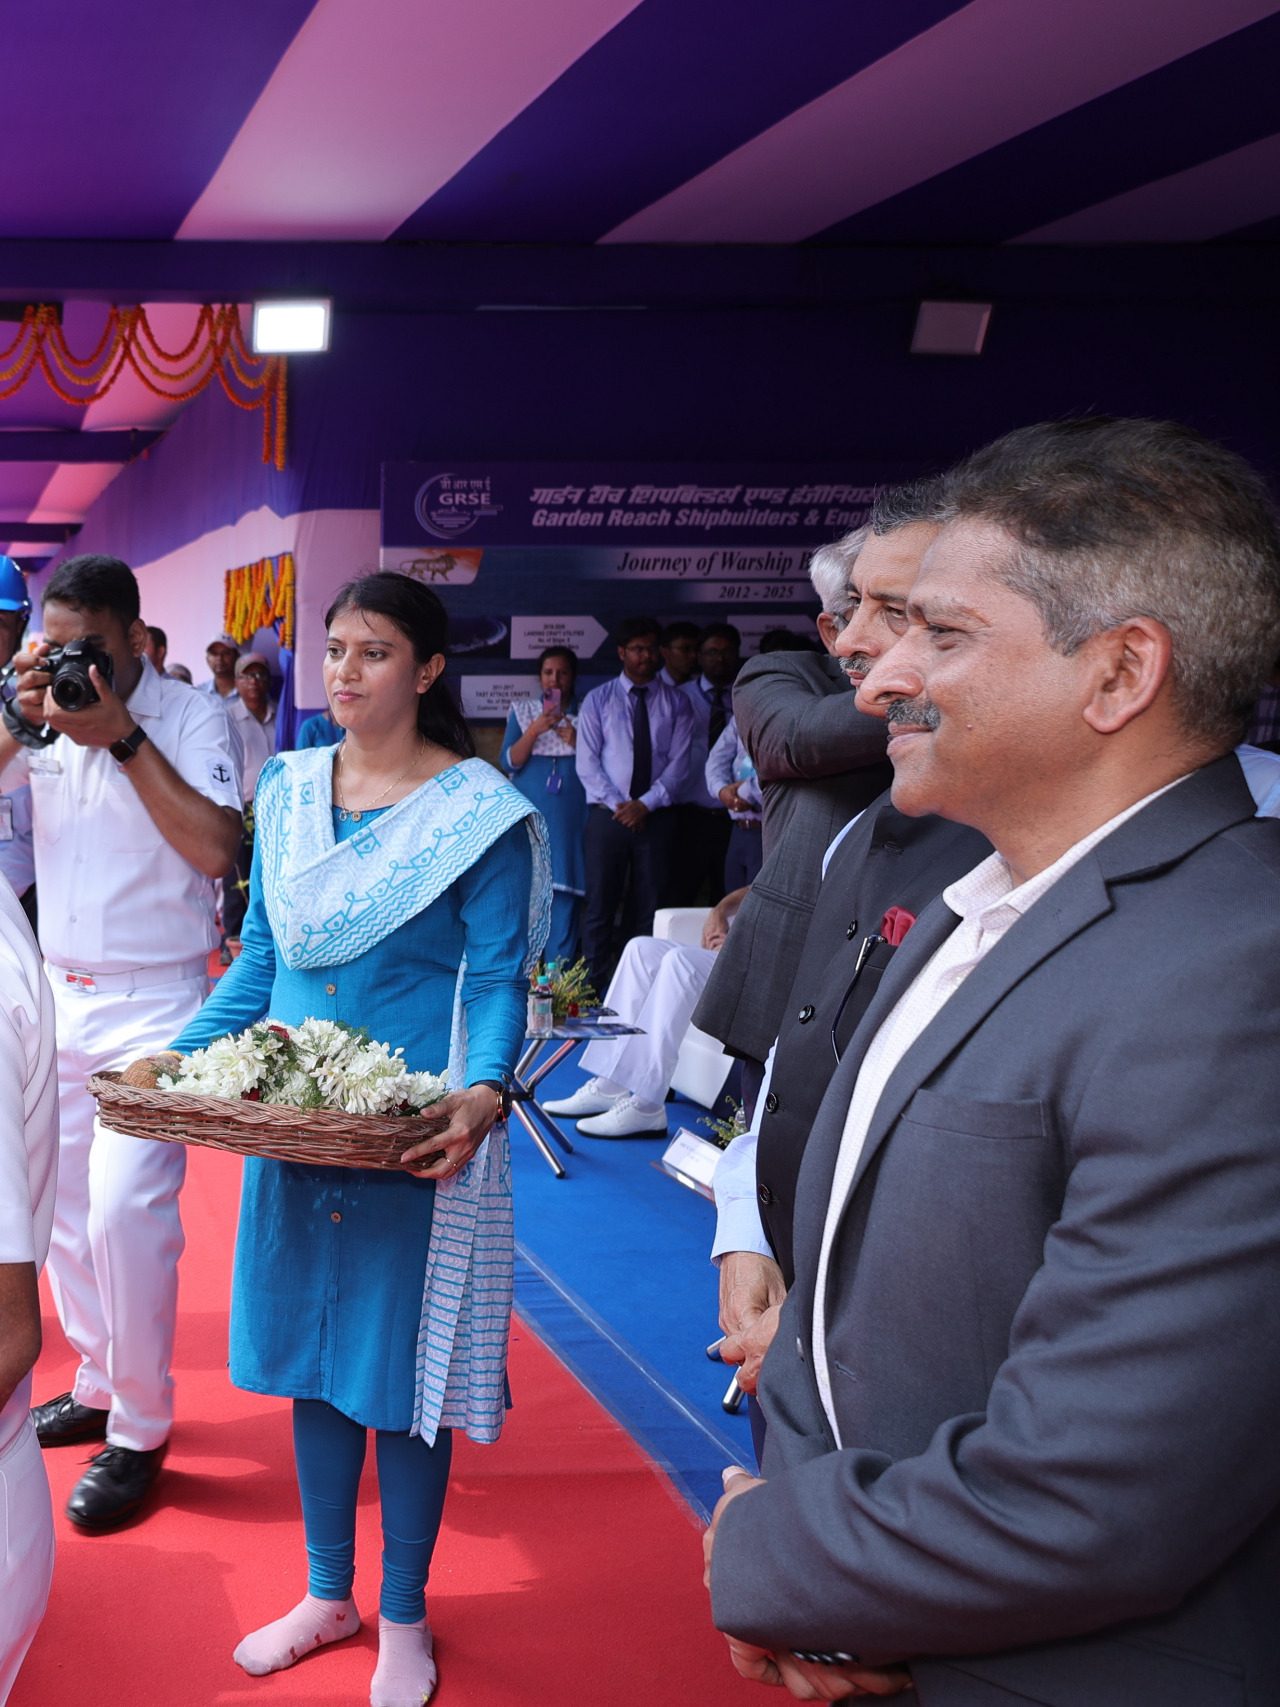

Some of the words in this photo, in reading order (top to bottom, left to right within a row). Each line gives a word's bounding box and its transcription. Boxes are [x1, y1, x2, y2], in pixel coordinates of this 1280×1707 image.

[453, 479, 468, 491] आर
[438, 492, 491, 505] GRSE
[530, 484, 586, 504] गार्डन
[587, 484, 627, 504] रीच
[627, 484, 744, 504] शिपबिल्डर्स
[743, 487, 790, 506] एण्ड
[531, 508, 605, 527] Garden
[606, 508, 671, 527] Reach
[674, 508, 800, 531] Shipbuilders
[803, 508, 820, 526] &
[617, 551, 692, 577] Journey
[696, 551, 719, 577] of
[720, 551, 793, 577] Warship
[718, 584, 752, 600] 2012
[762, 584, 794, 600] 2025
